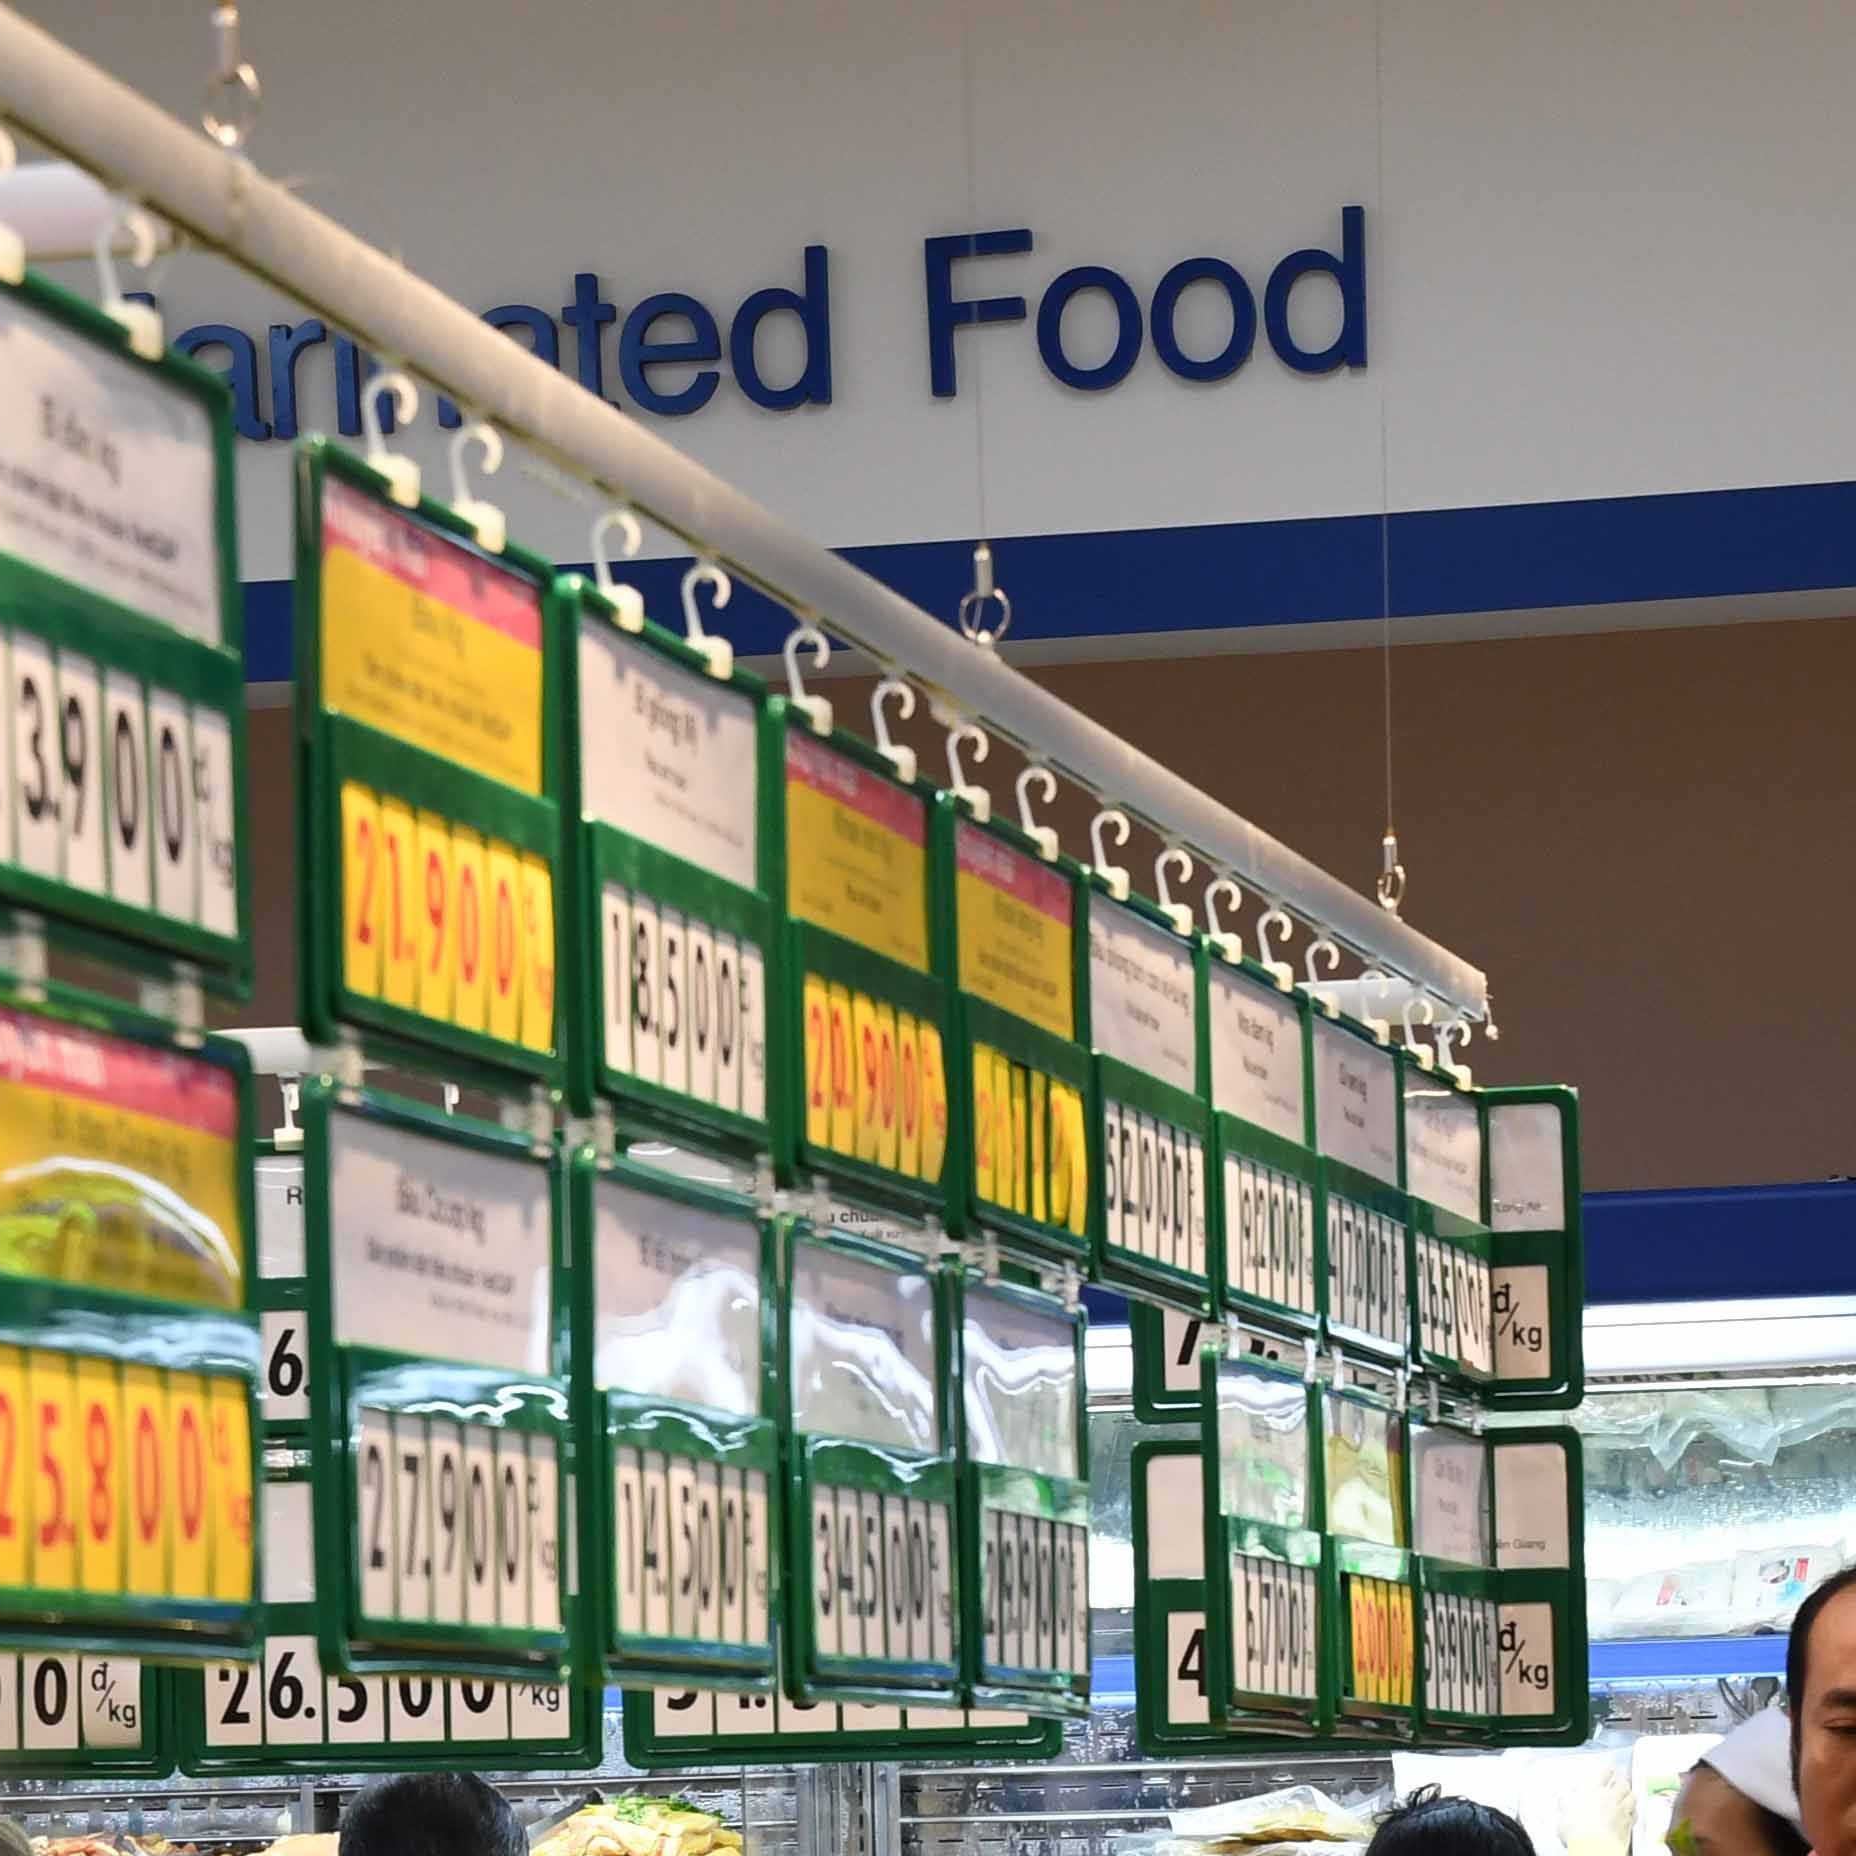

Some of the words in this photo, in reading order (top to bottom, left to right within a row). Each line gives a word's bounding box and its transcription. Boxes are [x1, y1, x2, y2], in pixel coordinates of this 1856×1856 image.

[924, 205, 1367, 398] Food
[612, 911, 734, 1068] 18.500
[367, 1445, 520, 1584] 27.900
[91, 1659, 137, 1730] đ/kg
[1499, 1620, 1550, 1691] đ/kg
